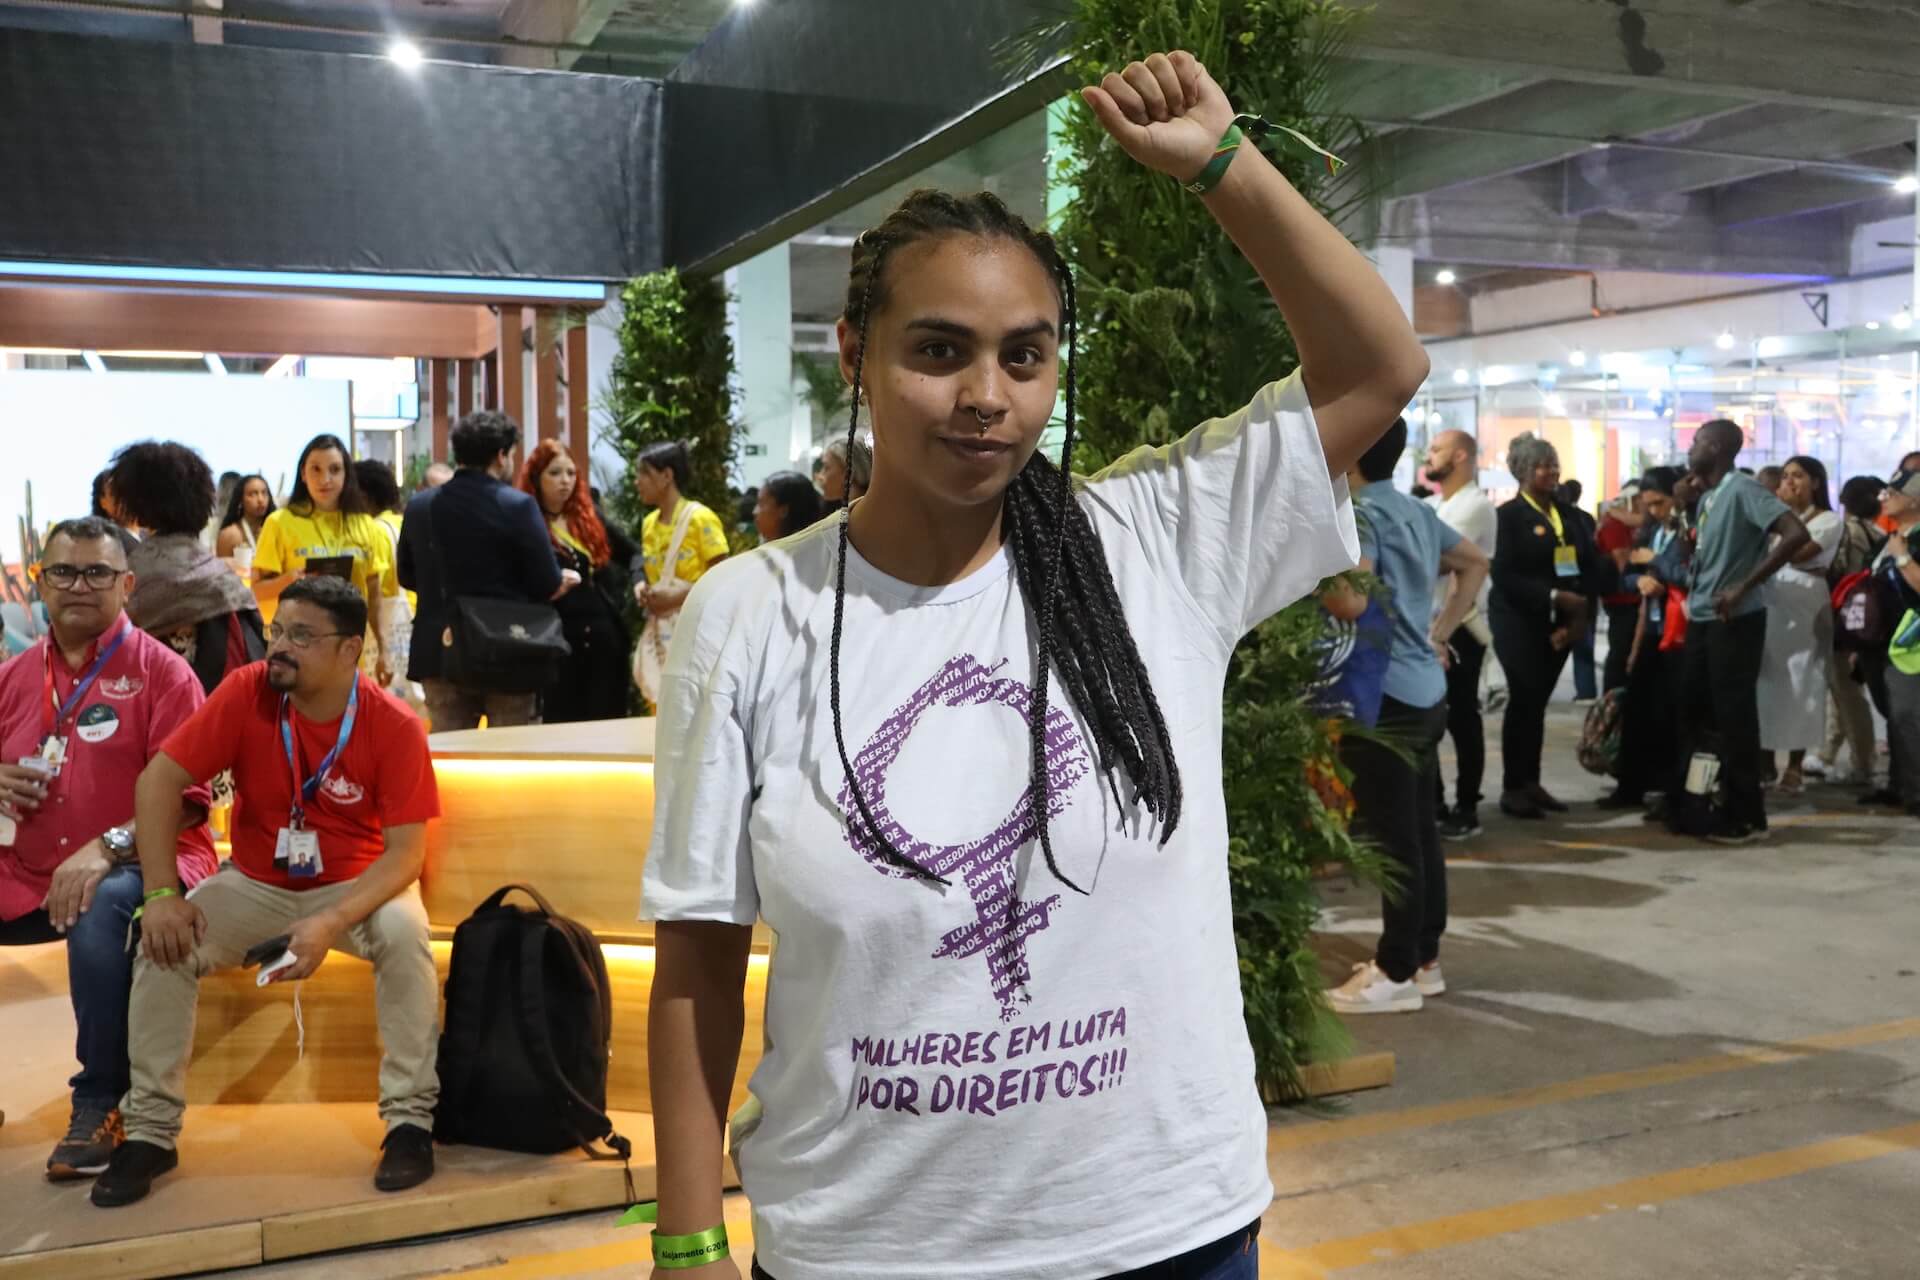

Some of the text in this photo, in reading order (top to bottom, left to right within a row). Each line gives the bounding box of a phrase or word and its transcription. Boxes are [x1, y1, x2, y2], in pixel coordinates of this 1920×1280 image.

[852, 1006, 1127, 1067] MULHERES EM LUTA
[857, 1047, 1128, 1117] POR DIREITOS!!!
